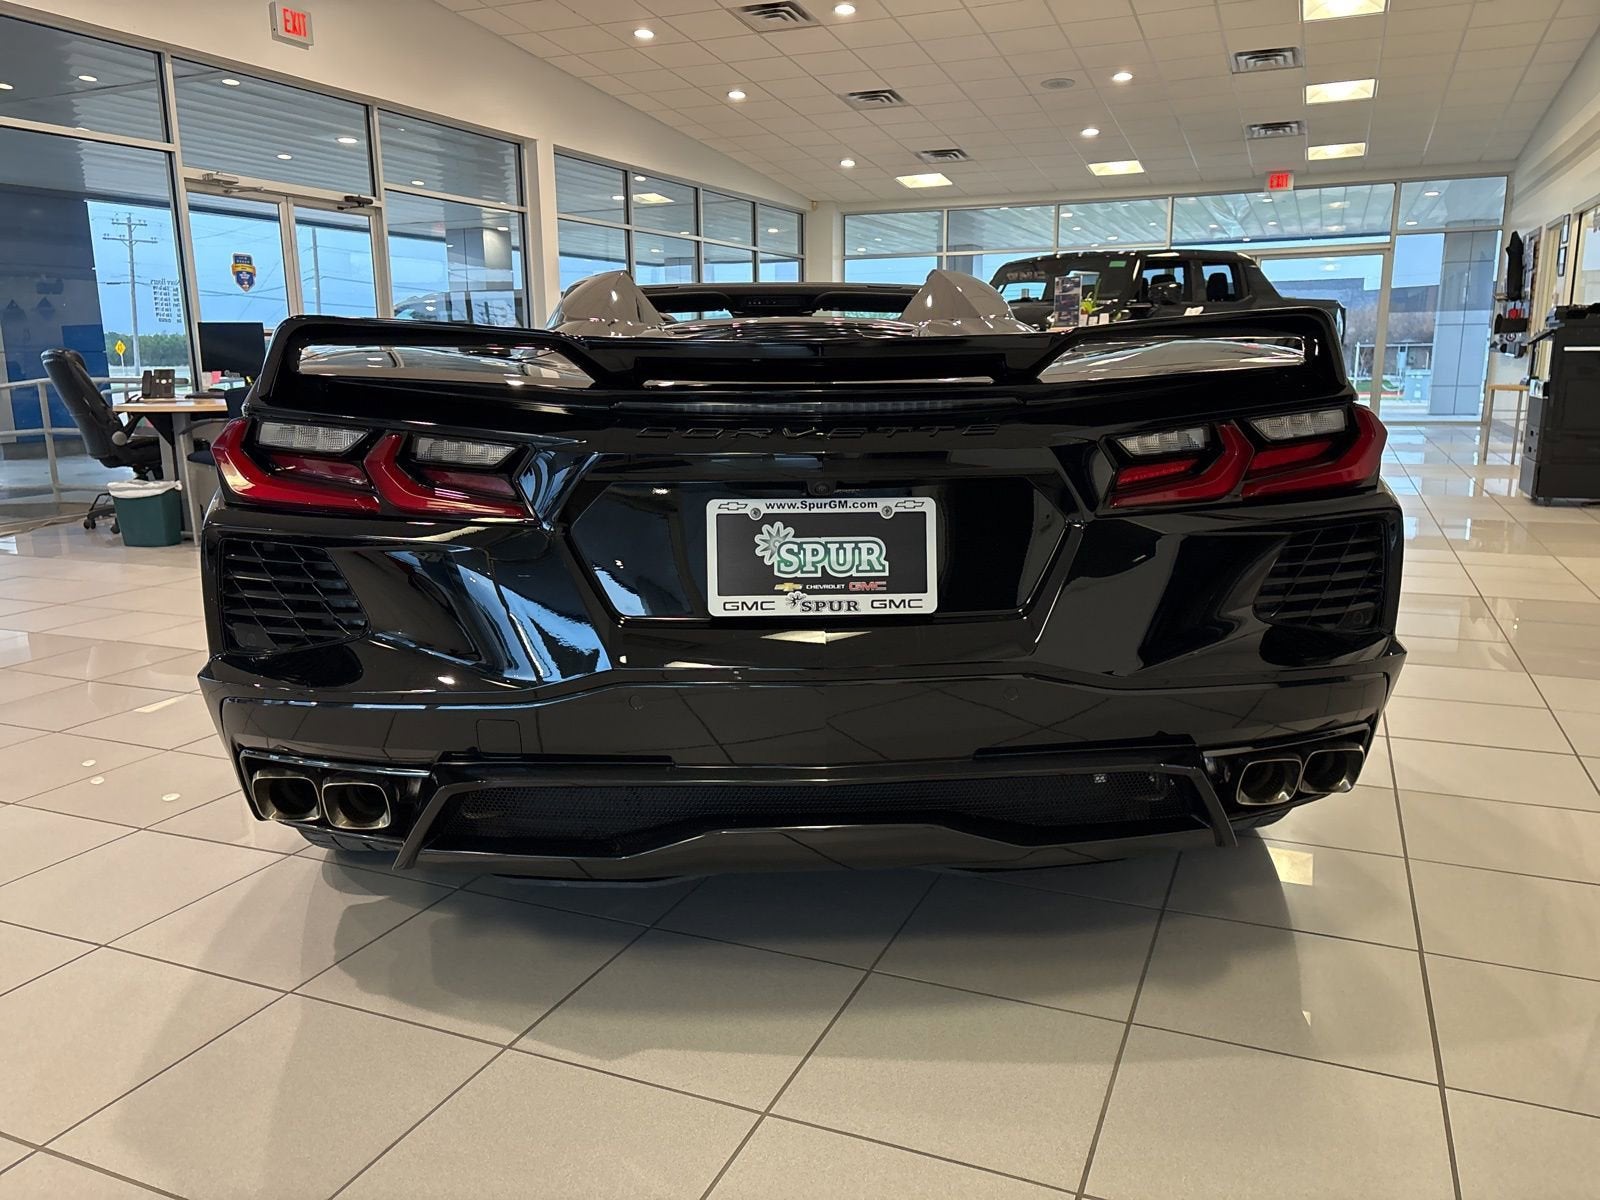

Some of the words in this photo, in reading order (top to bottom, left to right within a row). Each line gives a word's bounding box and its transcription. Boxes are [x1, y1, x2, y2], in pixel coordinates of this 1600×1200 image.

[282, 8, 307, 38] EXIT
[635, 424, 1000, 440] CORVETTE
[764, 500, 878, 511] www.SpurGM.com
[776, 539, 888, 576] SPUR
[848, 581, 887, 591] GMC
[723, 600, 776, 611] GMC
[801, 600, 860, 612] SPUR
[870, 598, 924, 609] GMC
